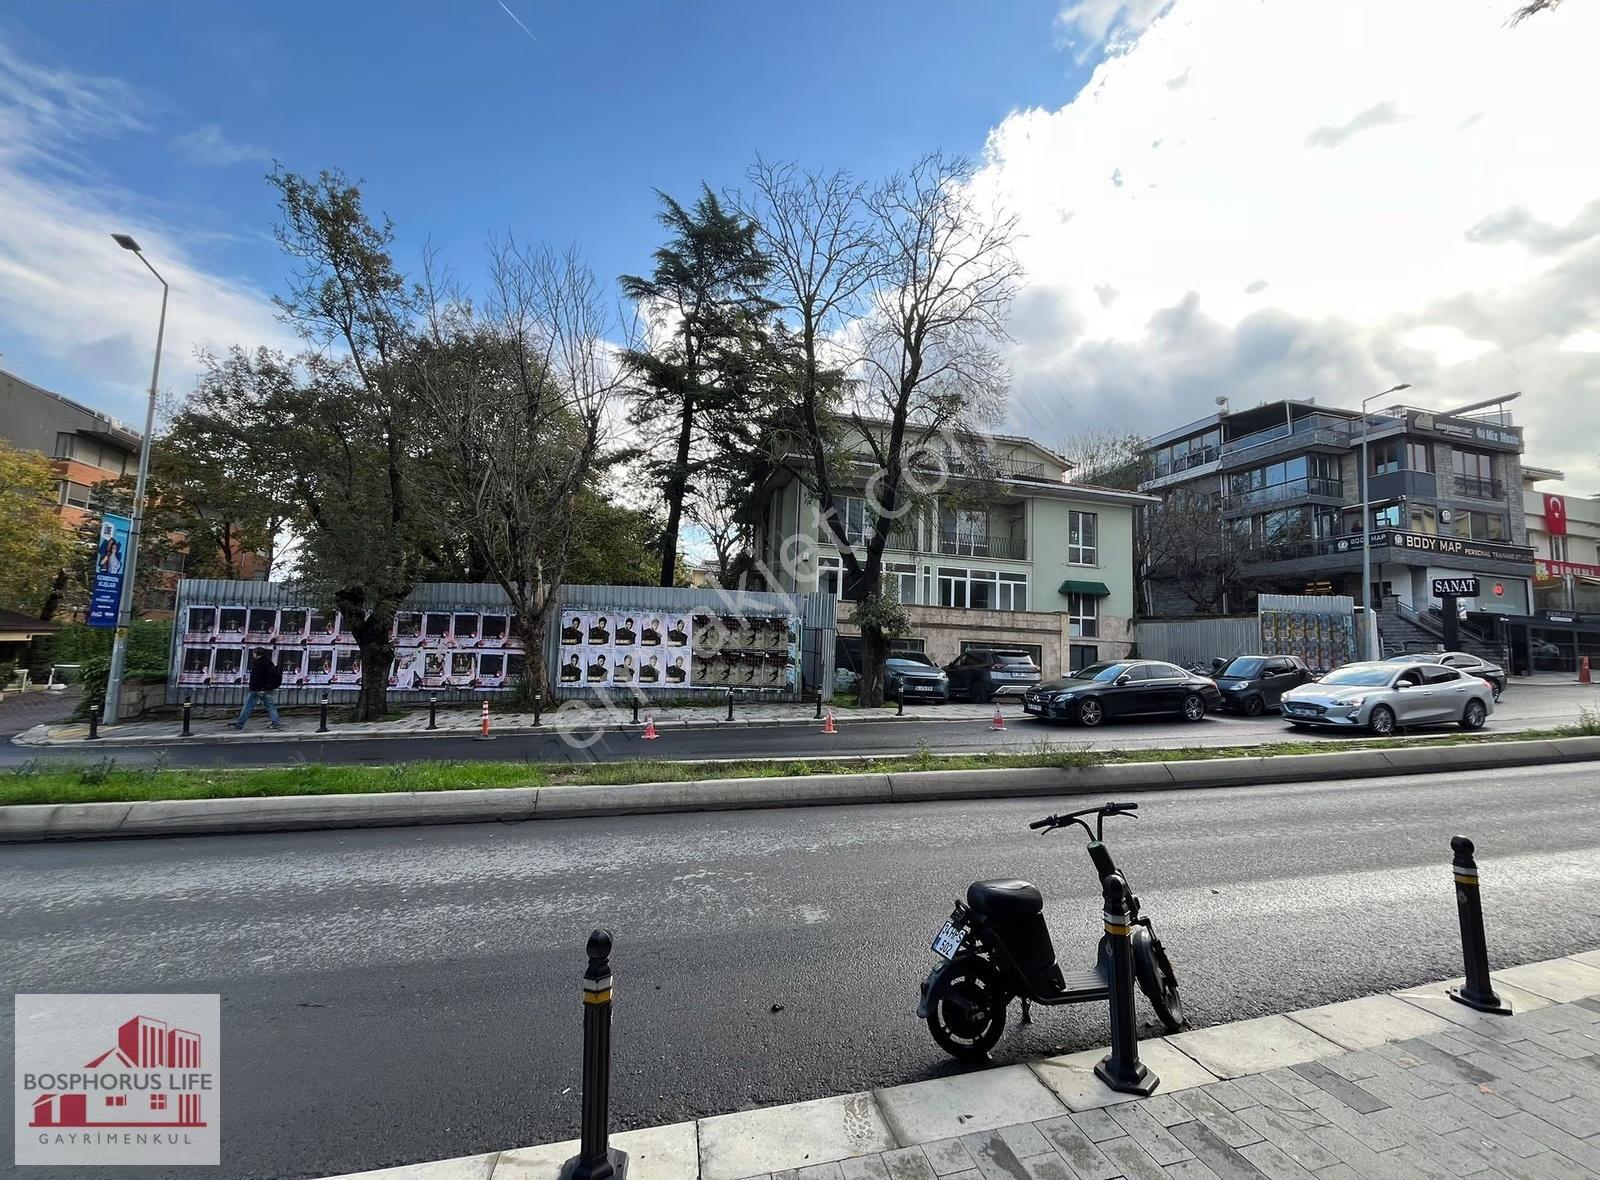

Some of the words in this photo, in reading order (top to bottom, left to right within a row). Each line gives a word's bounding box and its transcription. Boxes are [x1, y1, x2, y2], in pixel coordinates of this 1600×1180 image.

[1350, 537, 1366, 545] BOD
[1370, 534, 1386, 542] MAP
[1406, 535, 1436, 550] BODY
[1440, 540, 1462, 553] MAP
[1464, 548, 1491, 558] PERSONAL
[1435, 579, 1475, 593] SANAT
